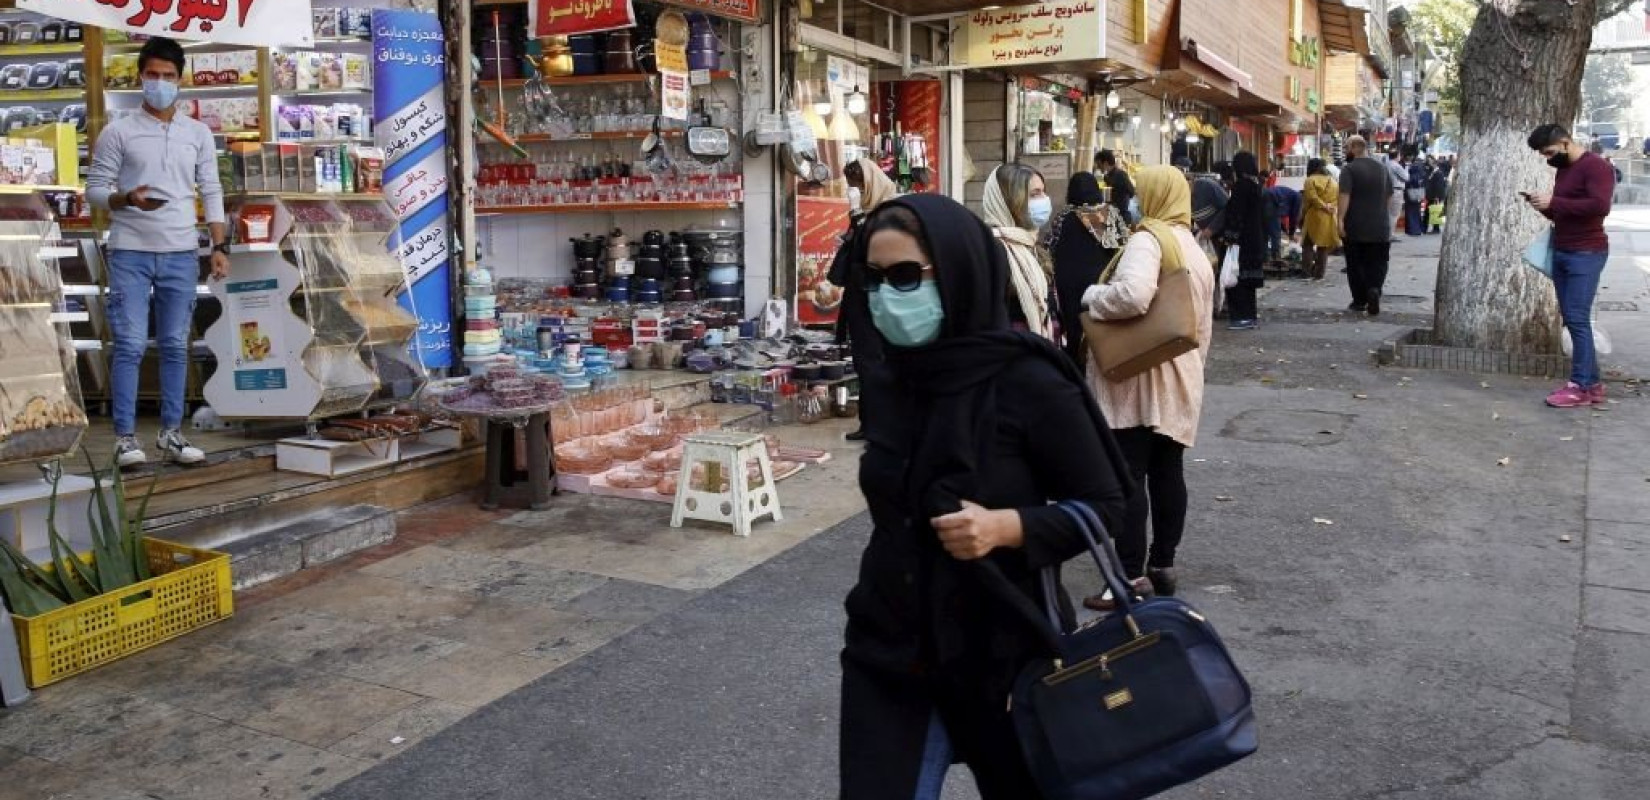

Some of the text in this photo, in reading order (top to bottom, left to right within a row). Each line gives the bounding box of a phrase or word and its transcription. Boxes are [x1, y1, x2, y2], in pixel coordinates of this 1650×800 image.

[995, 10, 1028, 25] سرویس
[1031, 5, 1053, 17] سلف
[378, 26, 444, 43] معجزه دیابت
[421, 50, 445, 67] عرق
[1015, 48, 1042, 59] ساندویچ
[1043, 44, 1063, 57] انواع
[393, 101, 427, 132] کپسول
[386, 112, 444, 158] شکم و پهلو
[420, 190, 427, 200] و
[415, 227, 443, 251] درمان
[420, 241, 446, 265] کبد
